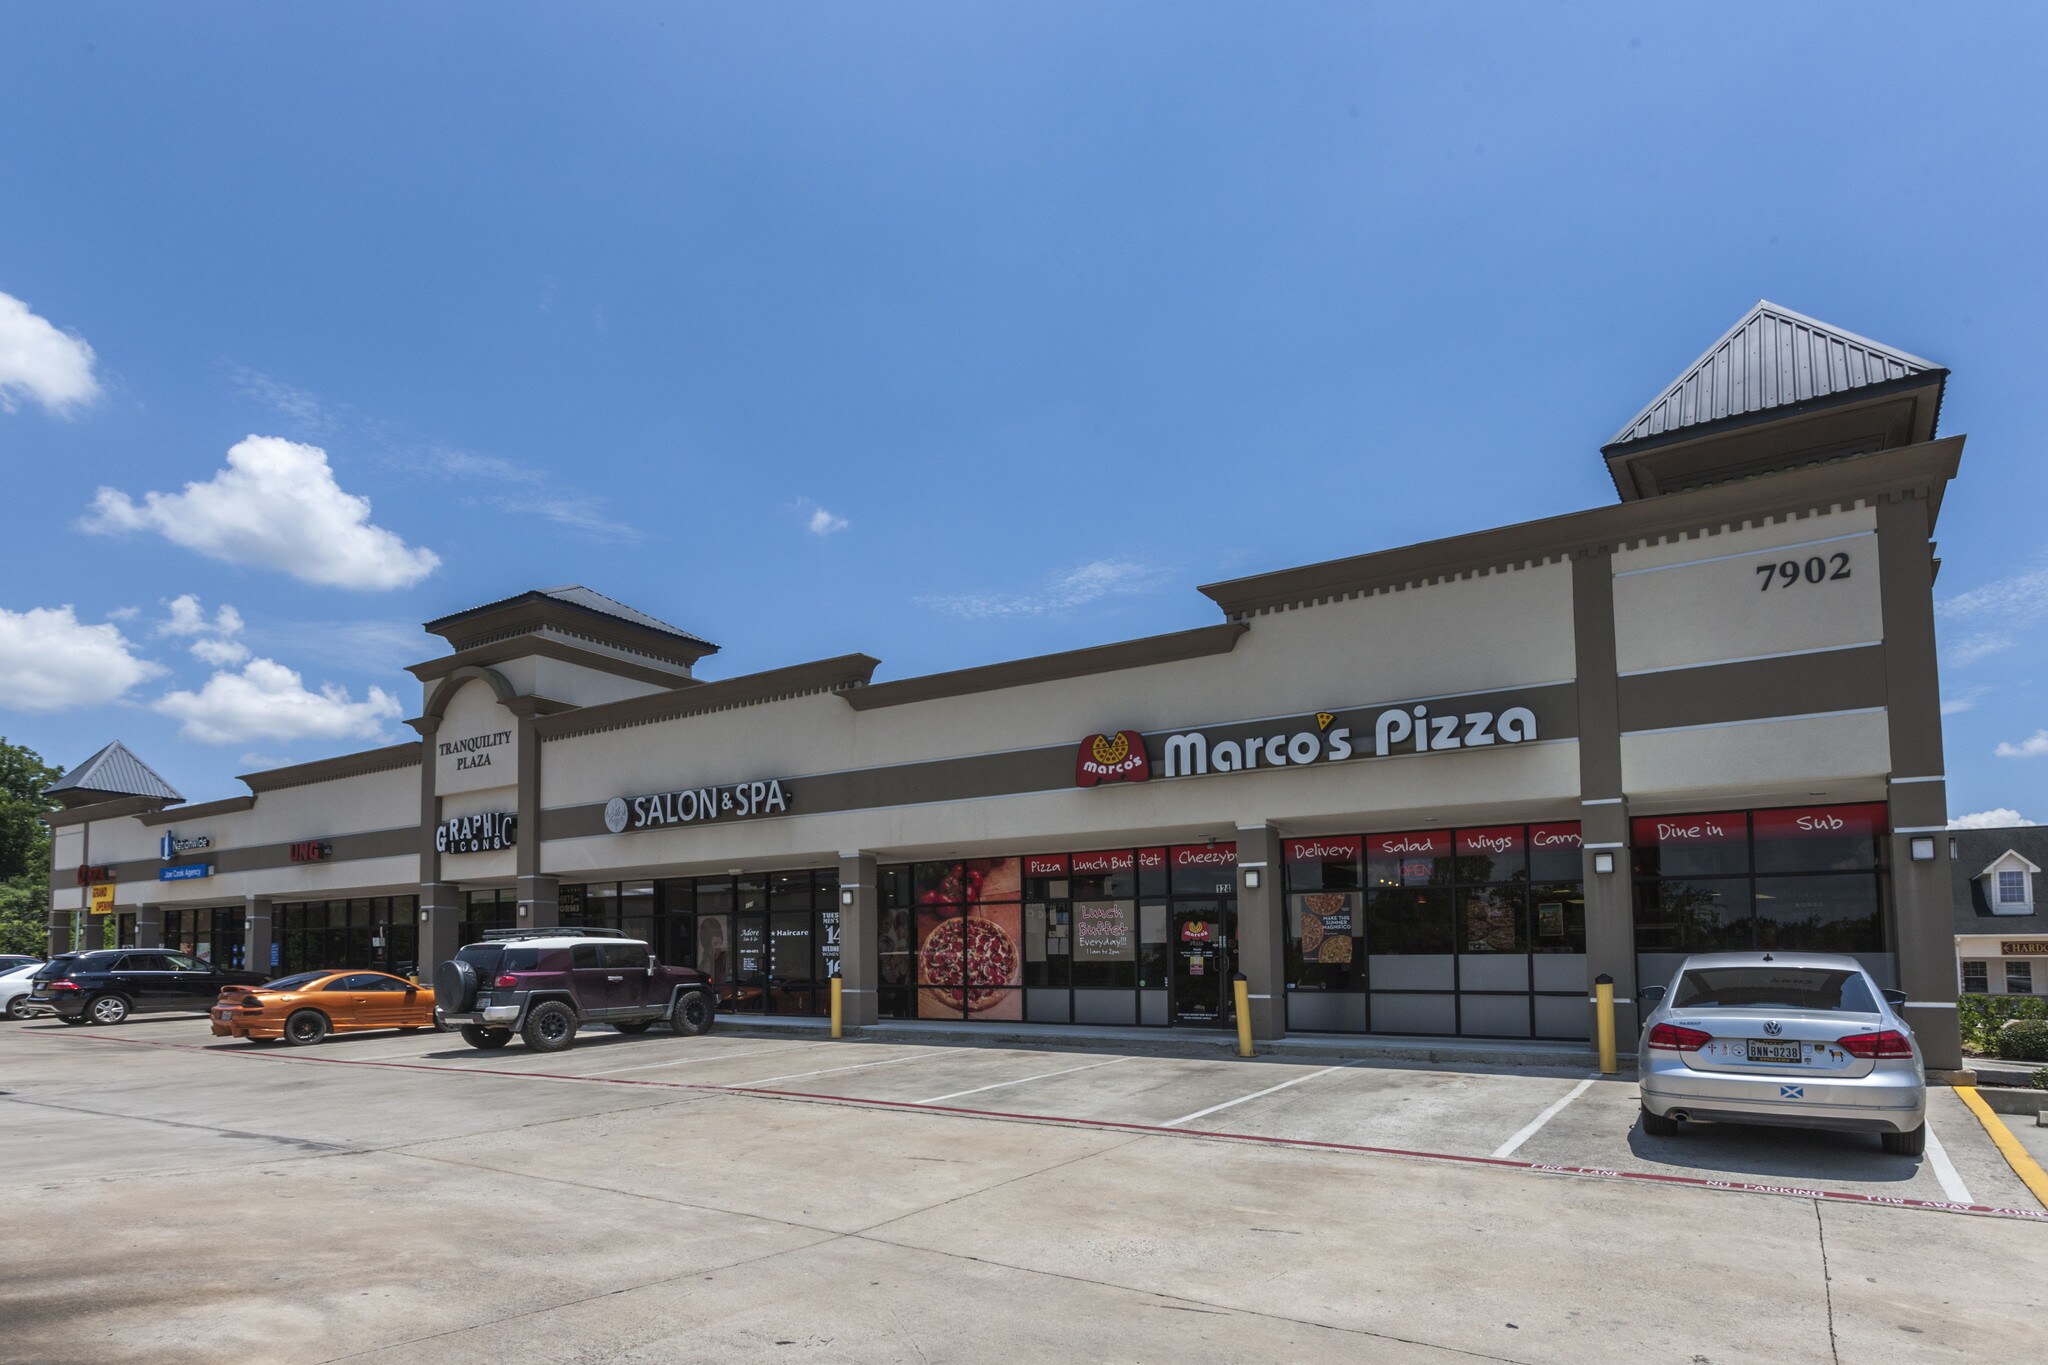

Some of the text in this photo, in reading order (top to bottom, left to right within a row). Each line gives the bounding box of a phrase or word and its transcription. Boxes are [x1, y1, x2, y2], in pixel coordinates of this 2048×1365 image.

[1756, 552, 1851, 591] 7902
[1375, 705, 1538, 757] Pizza
[439, 731, 512, 756] TRANQUILITY
[456, 753, 491, 770] PLAZA
[634, 780, 786, 827] SALON & SPA
[1657, 821, 1724, 840] Dine in
[1796, 814, 1843, 832] Sub
[436, 812, 512, 852] GRAPHIC
[1533, 831, 1583, 849] Carry
[172, 837, 207, 851] Nationwide
[450, 837, 501, 854] ICONS
[1295, 843, 1354, 859] Delivery
[1382, 838, 1433, 853] Salad
[1467, 835, 1512, 852] Wings
[1031, 861, 1061, 873] Pizza
[1072, 857, 1108, 871] Lunch
[1400, 863, 1432, 877] OPEN
[173, 869, 184, 877] Cook
[185, 869, 202, 878] Agency
[1216, 884, 1231, 893] 124
[1081, 904, 1124, 919] Lunch
[1078, 920, 1129, 937] Buffet
[1531, 1163, 1563, 1171] FIRE
[1579, 1168, 1620, 1177] LANE
[1706, 1180, 1731, 1188] NO
[1743, 1183, 1824, 1197] PARKING
[1866, 1195, 1905, 1204] TOW
[1921, 1201, 1971, 1210] AWAY
